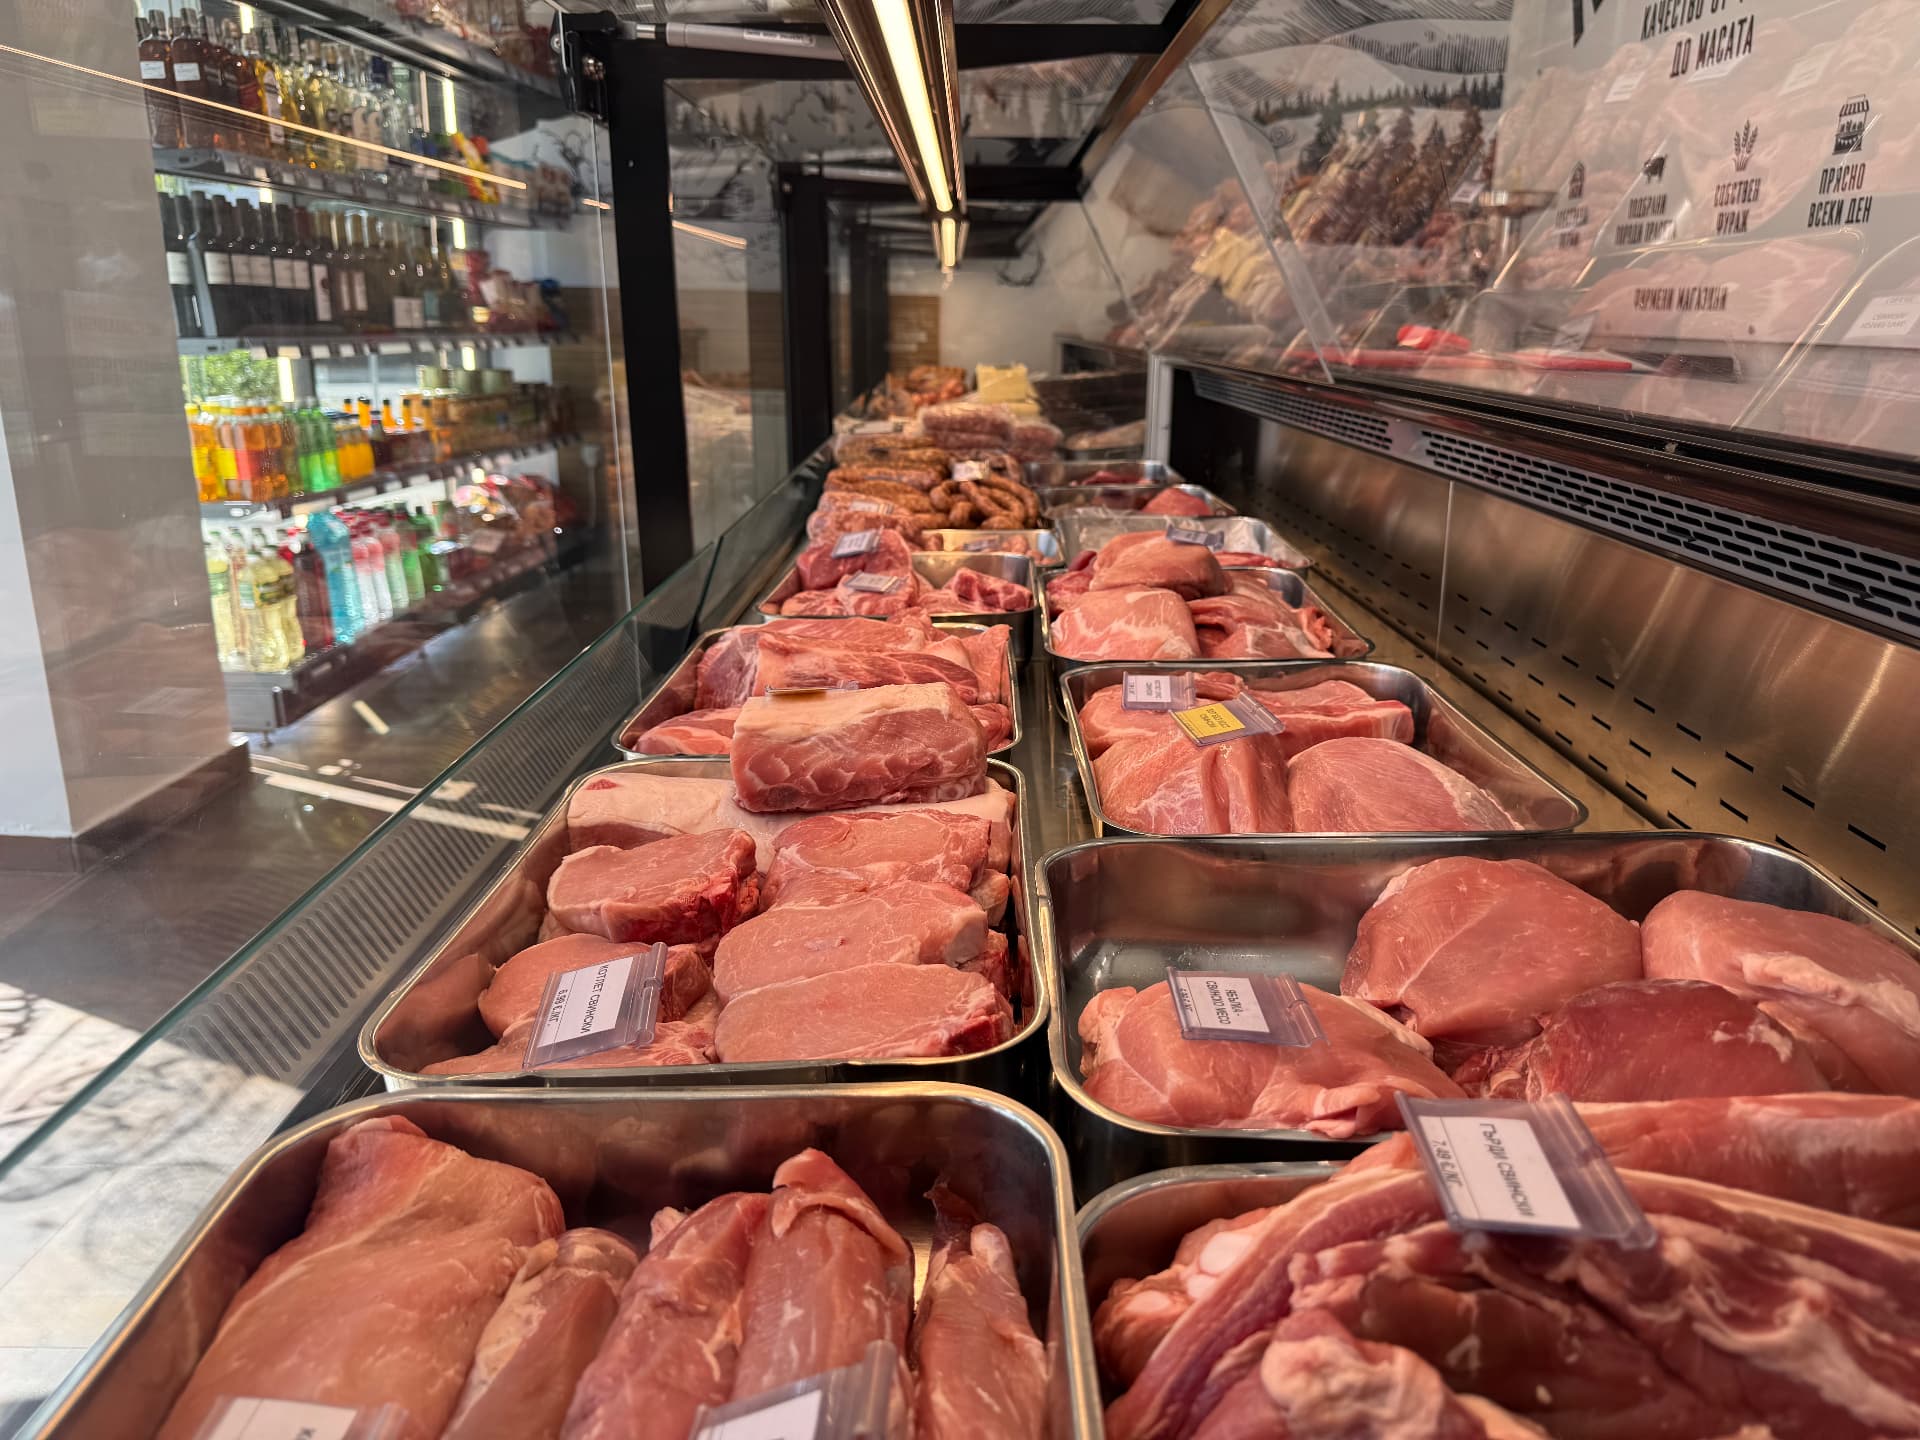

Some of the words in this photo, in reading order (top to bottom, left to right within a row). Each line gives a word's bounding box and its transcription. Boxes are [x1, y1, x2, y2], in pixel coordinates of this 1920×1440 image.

[1670, 38, 1691, 78] ДО
[1696, 14, 1755, 71] МАСАТА
[1818, 162, 1867, 195] ПРЯСНО
[1807, 199, 1844, 228] ВСЕКИ
[1844, 196, 1873, 225] ДЕН
[592, 964, 608, 992] КОТЛЕТ
[1206, 981, 1225, 1007] СВИНСКО
[580, 994, 600, 1033] СВИНСКИ
[1214, 1006, 1232, 1025] МЕСО
[1480, 1123, 1510, 1160] ГЪРДИ
[1497, 1161, 1535, 1216] СВИНСКИ
